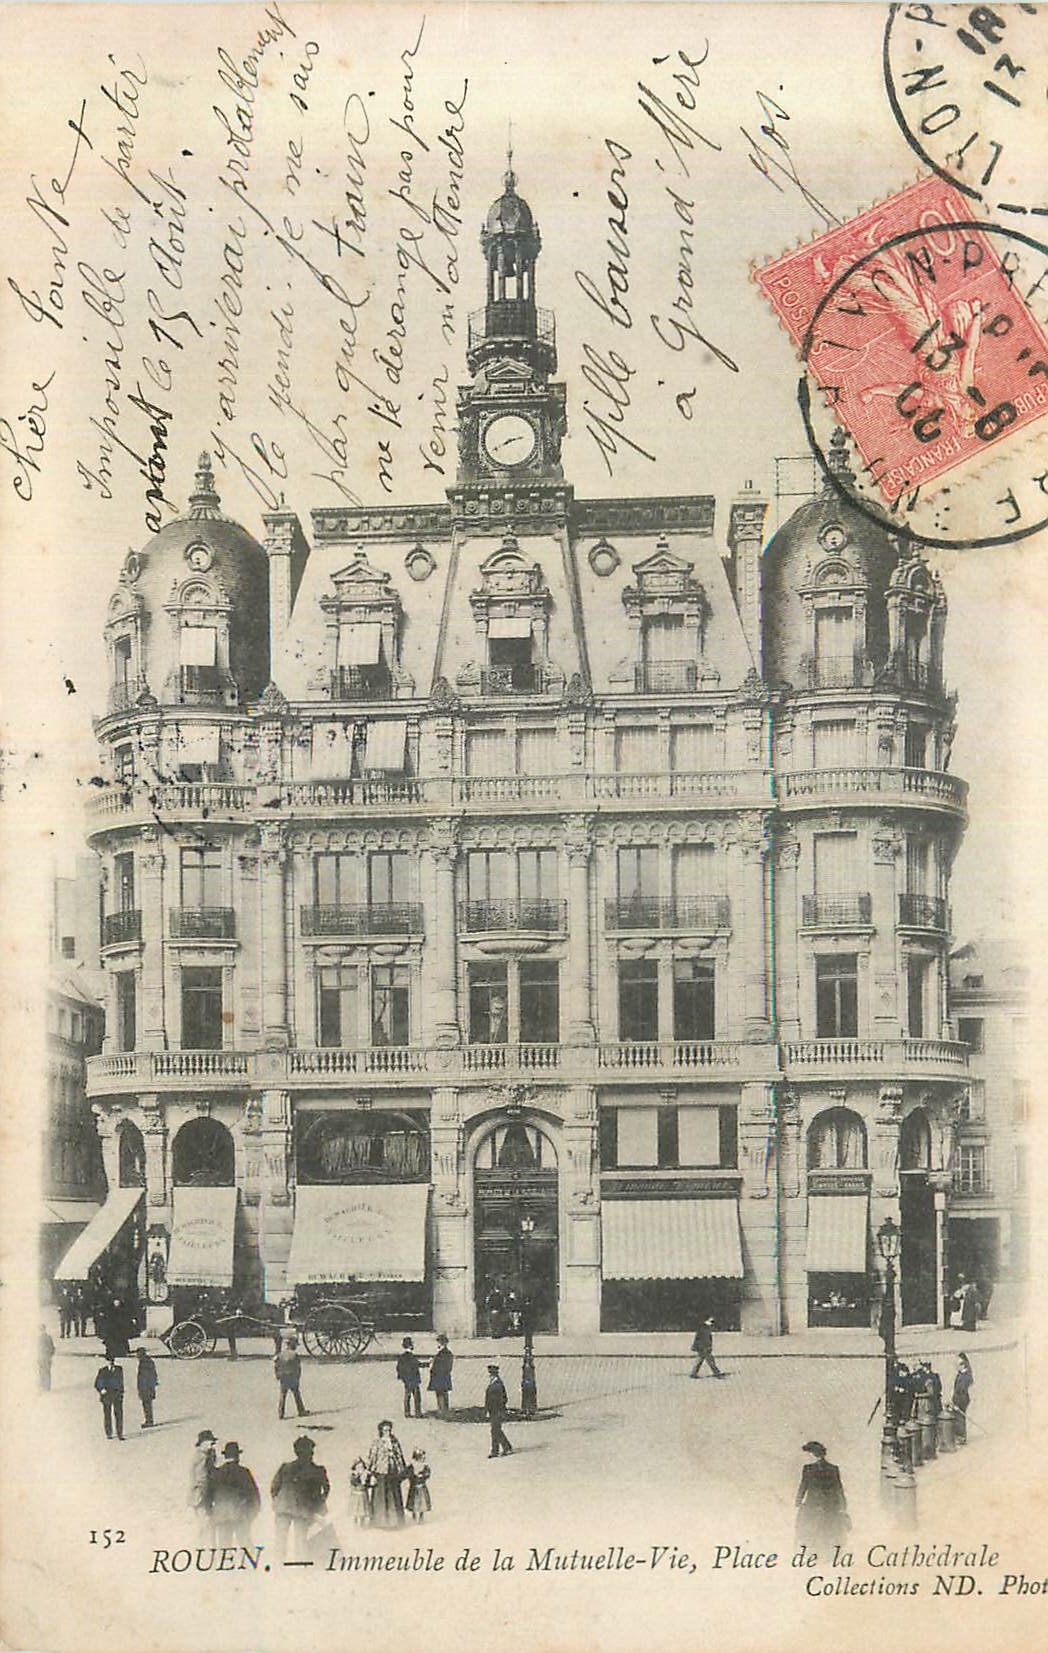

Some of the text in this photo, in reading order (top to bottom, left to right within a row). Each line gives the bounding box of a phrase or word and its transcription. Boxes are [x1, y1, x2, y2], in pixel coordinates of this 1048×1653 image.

[281, 40, 320, 112] sais
[389, 14, 428, 151] pour
[285, 140, 304, 197] ne
[388, 145, 432, 225] pas
[101, 205, 132, 251] de
[573, 137, 634, 330] baisers
[141, 355, 174, 393] le
[322, 275, 387, 402] quel
[312, 414, 364, 508] par
[377, 440, 392, 494] ne
